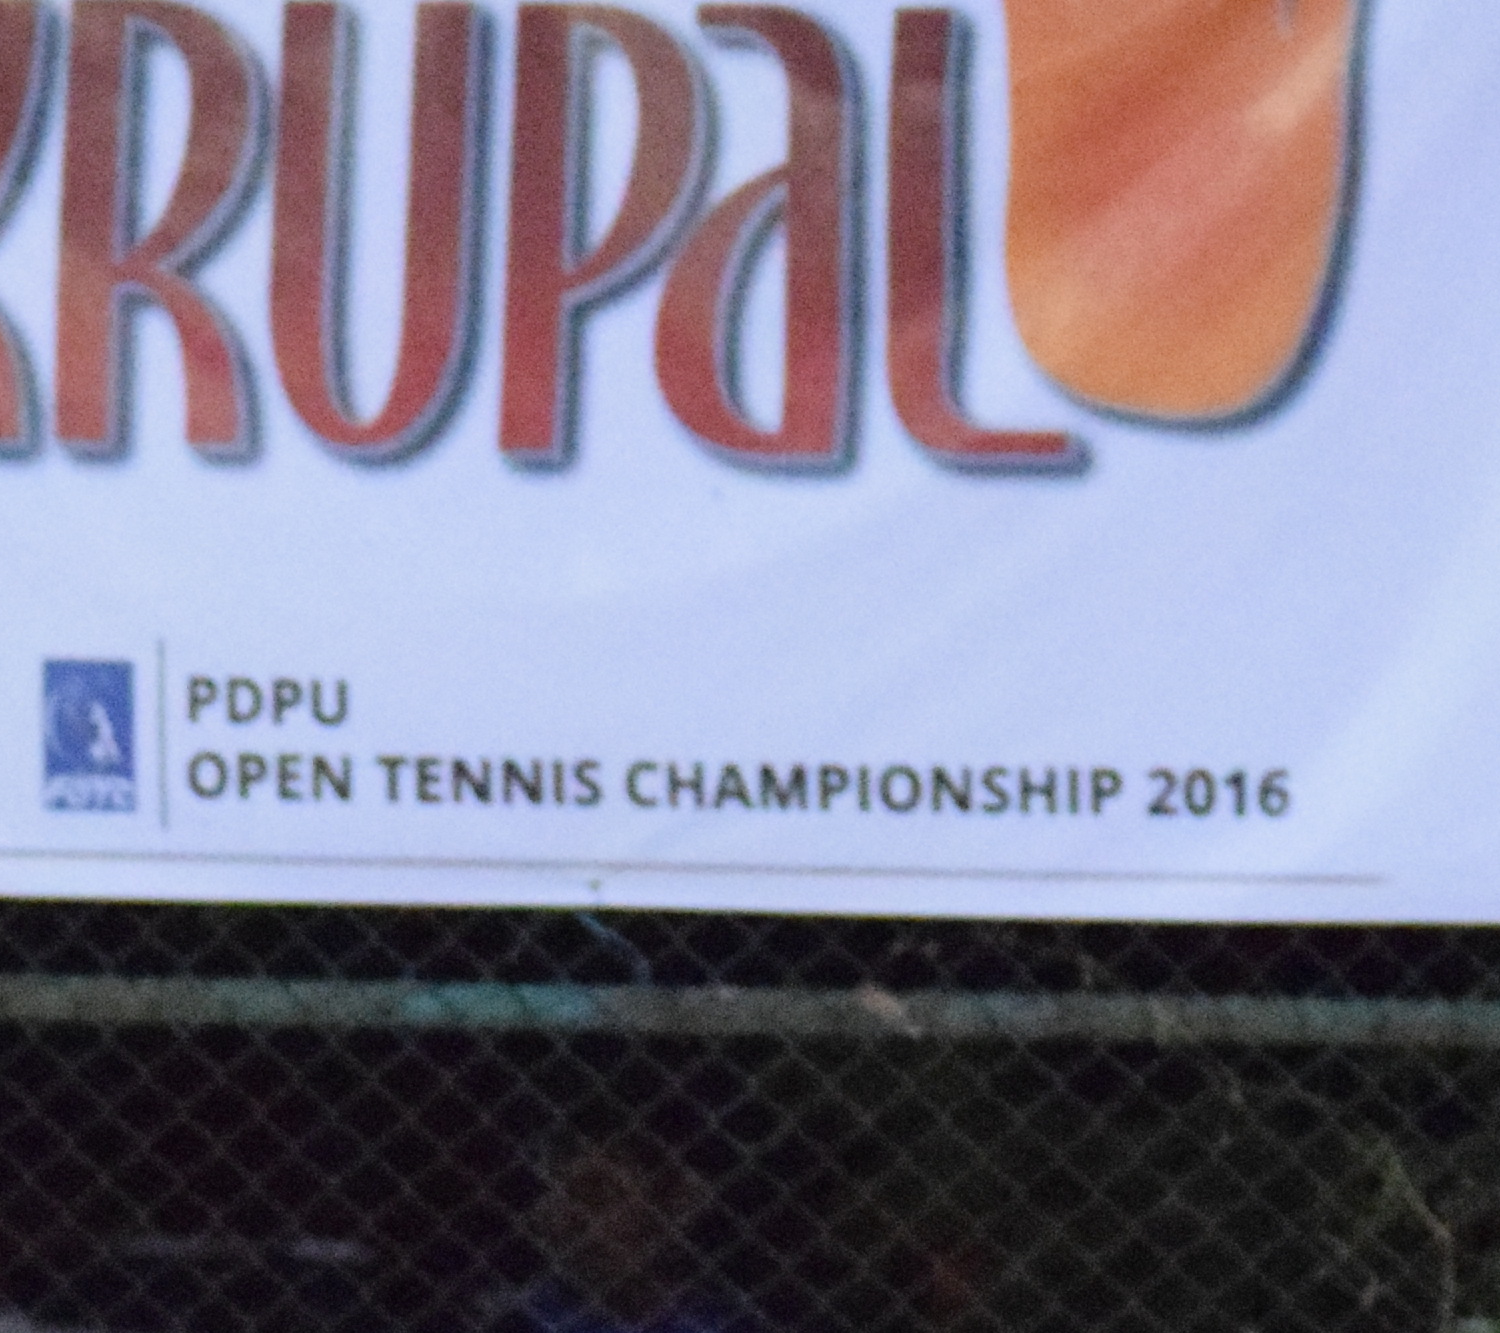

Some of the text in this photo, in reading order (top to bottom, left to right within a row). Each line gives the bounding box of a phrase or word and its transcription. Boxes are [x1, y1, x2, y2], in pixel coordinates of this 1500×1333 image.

[185, 674, 352, 729] PDPU
[185, 749, 355, 804] OPEN
[375, 753, 605, 810] TENNIS
[623, 758, 1125, 817] CHAMPIONSHIP
[1145, 766, 1292, 820] 2016
